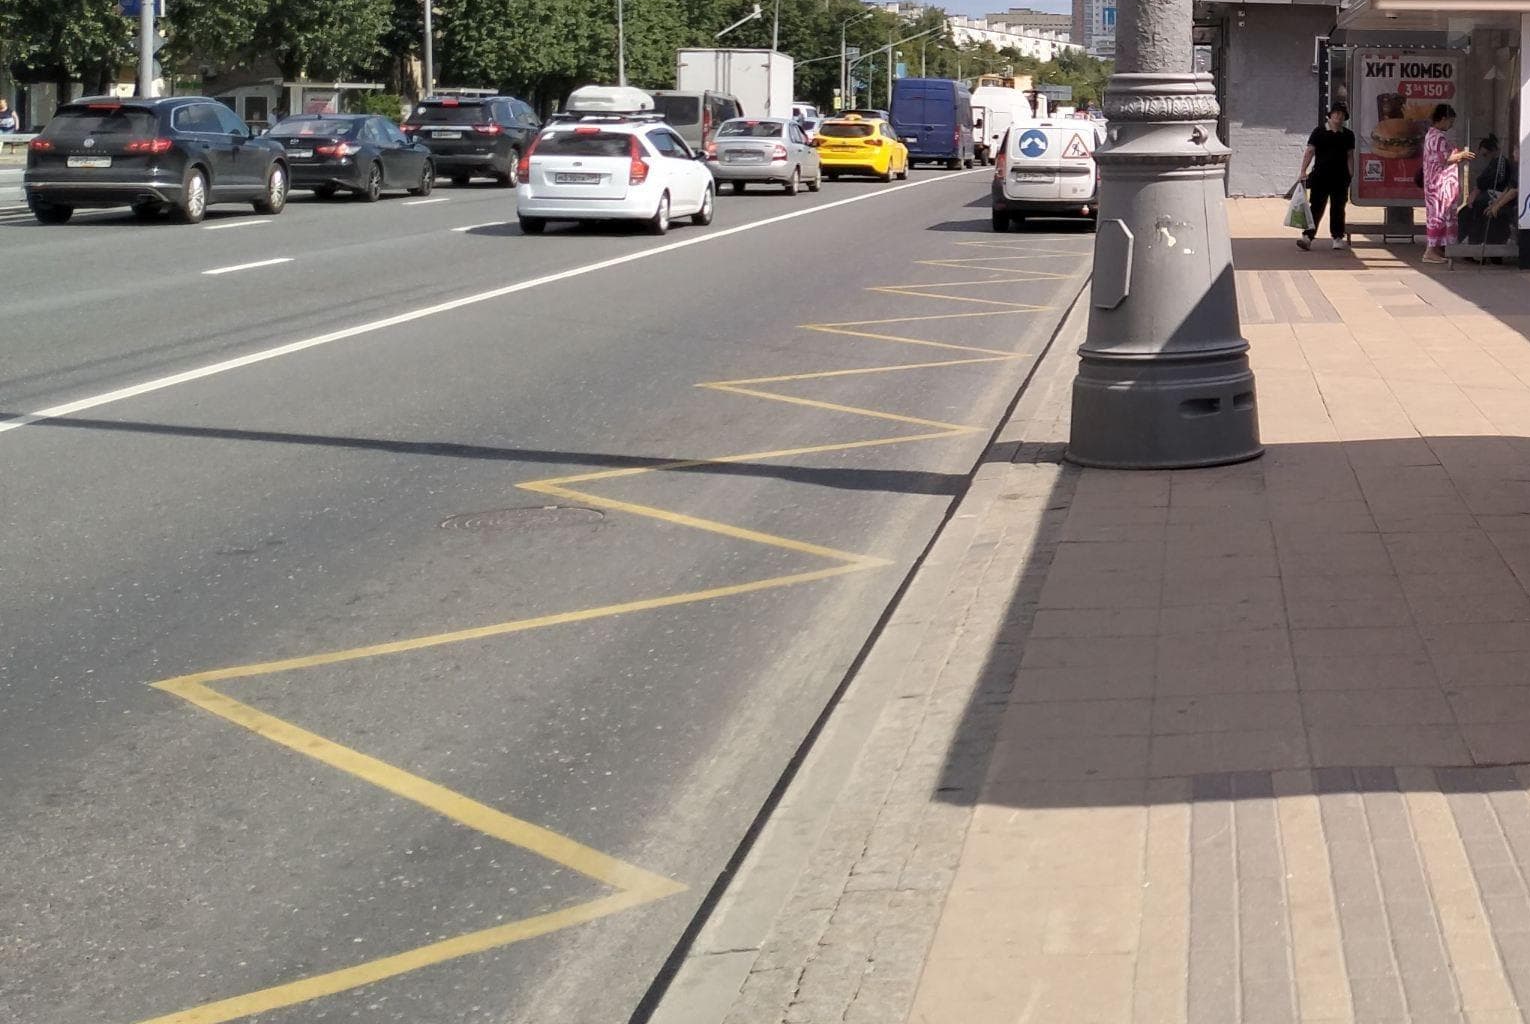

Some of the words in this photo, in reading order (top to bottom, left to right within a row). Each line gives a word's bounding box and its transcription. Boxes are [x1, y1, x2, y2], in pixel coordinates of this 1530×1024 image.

[1366, 62, 1396, 78] ХИТ
[1400, 62, 1453, 78] КОМБО
[1405, 83, 1413, 96] 3
